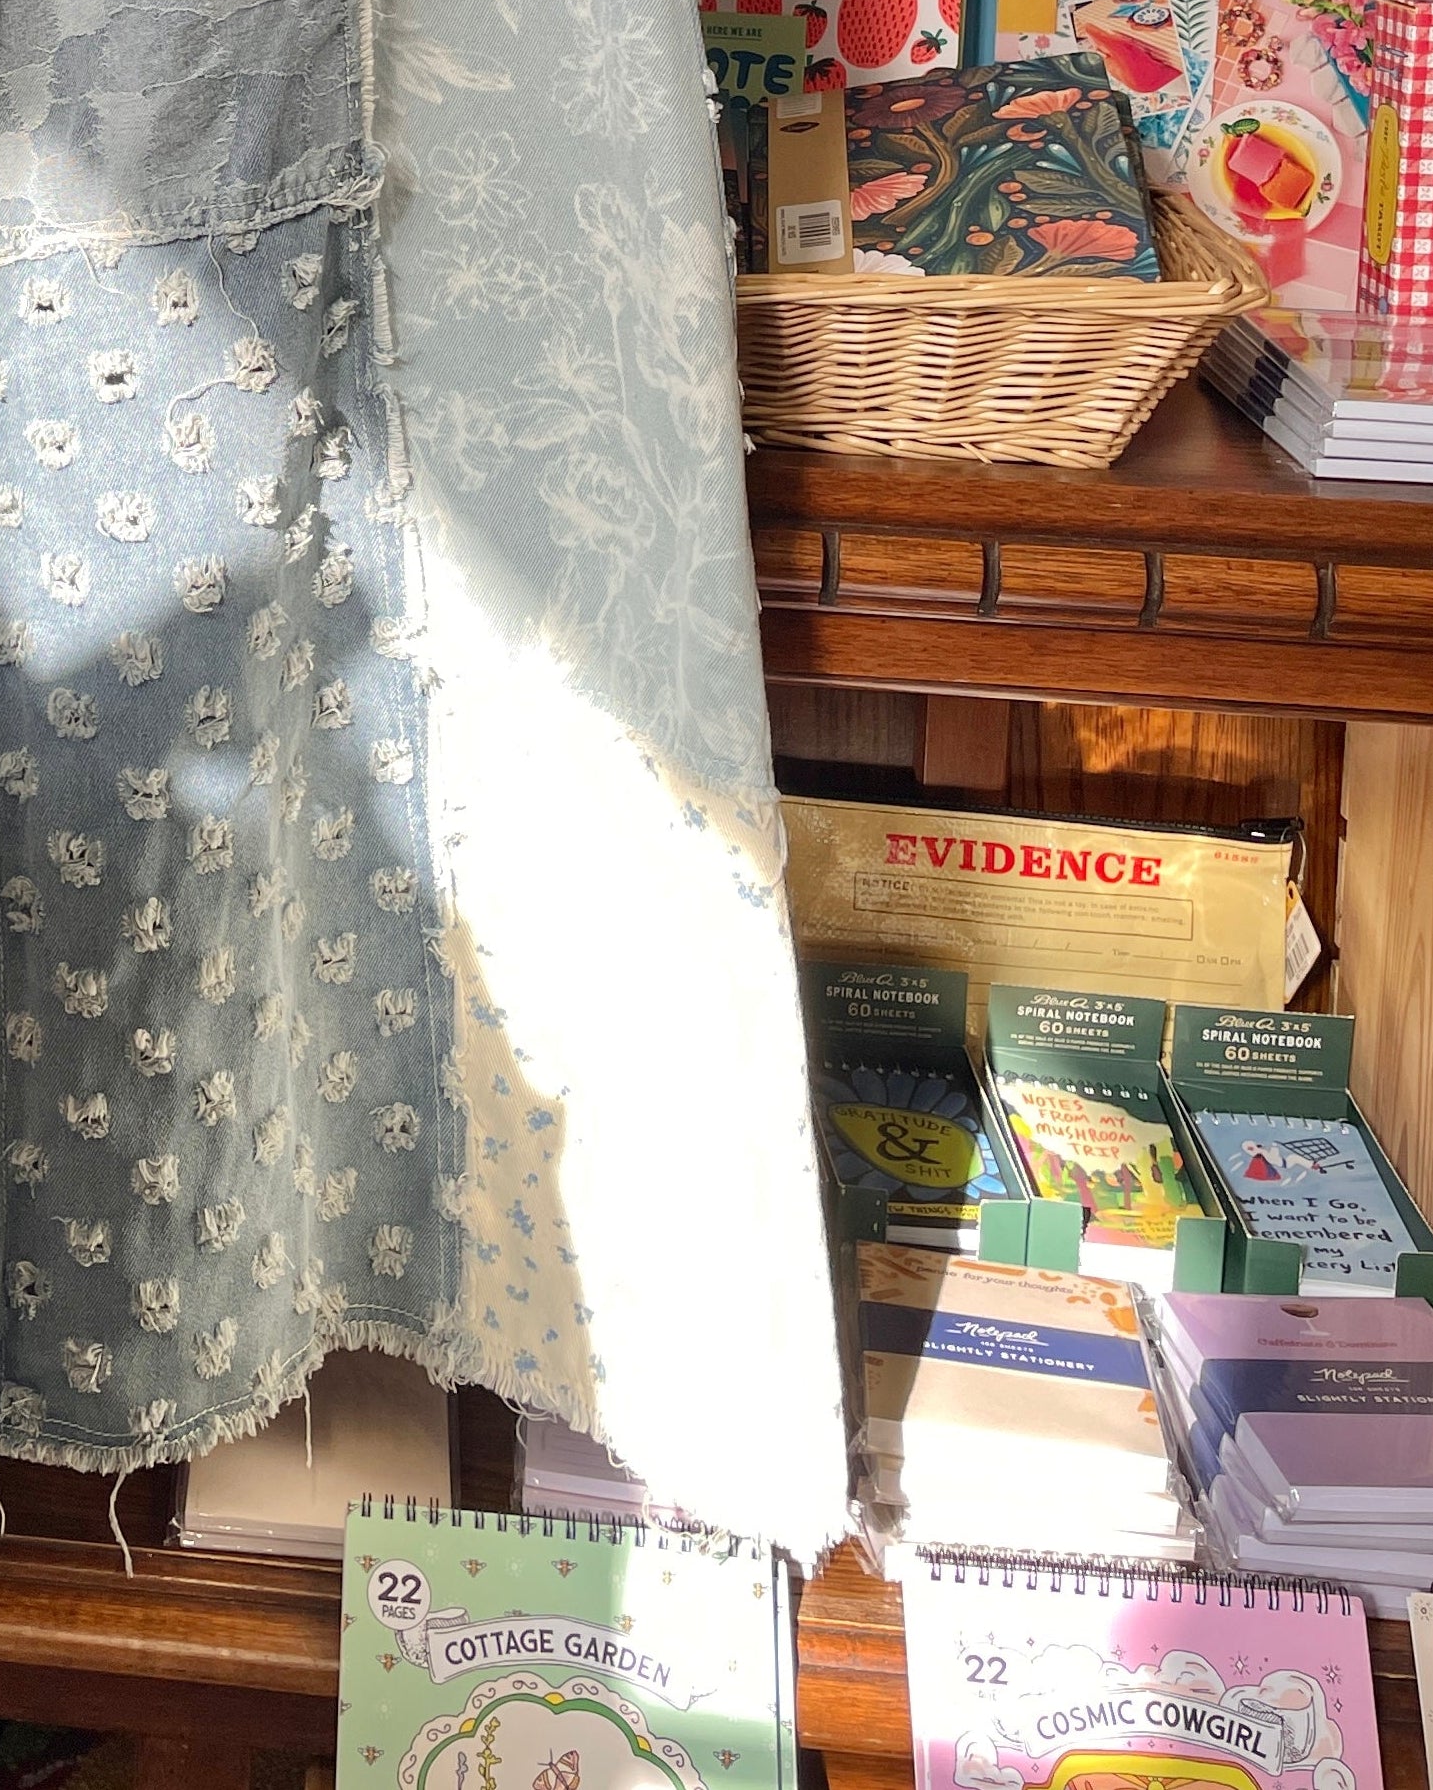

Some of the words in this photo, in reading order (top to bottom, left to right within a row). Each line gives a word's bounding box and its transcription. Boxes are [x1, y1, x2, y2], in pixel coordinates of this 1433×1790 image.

[706, 26, 728, 36] HERE
[730, 27, 744, 37] WE
[746, 28, 763, 38] ARE
[706, 47, 796, 95] OTE
[885, 833, 1162, 887] EVIDENCE
[826, 985, 868, 1000] SPIRAL
[873, 989, 940, 1005] NOTEBOOK
[848, 1002, 871, 1018] 60
[873, 1009, 916, 1019] SHEETS
[1017, 1005, 1061, 1020] SPIRAL
[1065, 1011, 1135, 1026] NOTEBOOK
[1039, 1020, 1064, 1034] 60
[1065, 1027, 1109, 1037] SHEETS
[1202, 1029, 1247, 1044] SPIRAL
[1251, 1033, 1322, 1049] NOTEBOOK
[1224, 1046, 1250, 1061] 60
[1252, 1052, 1296, 1063] SHEETS
[1021, 1093, 1084, 1111] NOTES
[834, 1106, 953, 1136] GRATITUDE
[1039, 1110, 1089, 1123] FROM
[1100, 1116, 1126, 1128] MY
[1036, 1123, 1136, 1143] MUSHROOM
[876, 1122, 942, 1165] &
[1070, 1143, 1120, 1159] TRIP
[905, 1163, 952, 1179] SHIT
[1235, 1195, 1294, 1207] When
[1302, 1197, 1318, 1208] I
[1329, 1198, 1367, 1212] Go,
[1243, 1211, 1260, 1222] I
[1267, 1212, 1318, 1223] want
[1327, 1214, 1349, 1224] to
[1353, 1214, 1377, 1227] be
[1313, 1246, 1344, 1258] my
[1302, 1260, 1352, 1274] cery
[963, 1272, 983, 1282] for
[982, 1276, 1015, 1286] your
[1018, 1280, 1074, 1295] thoughts
[923, 1341, 994, 1358] SLIGHTLY
[1000, 1352, 1096, 1372] STATIONERY
[1297, 1394, 1367, 1404] SLIGHTLY
[1374, 1395, 1433, 1404] STATION
[378, 1571, 422, 1604] 22
[382, 1604, 416, 1620] PAGES
[445, 1628, 554, 1665] COTTAGE
[564, 1633, 671, 1687] GARDEN
[964, 1654, 1008, 1685] 22
[1036, 1699, 1135, 1740] COSMIC
[1145, 1701, 1267, 1759] COWGIRL
